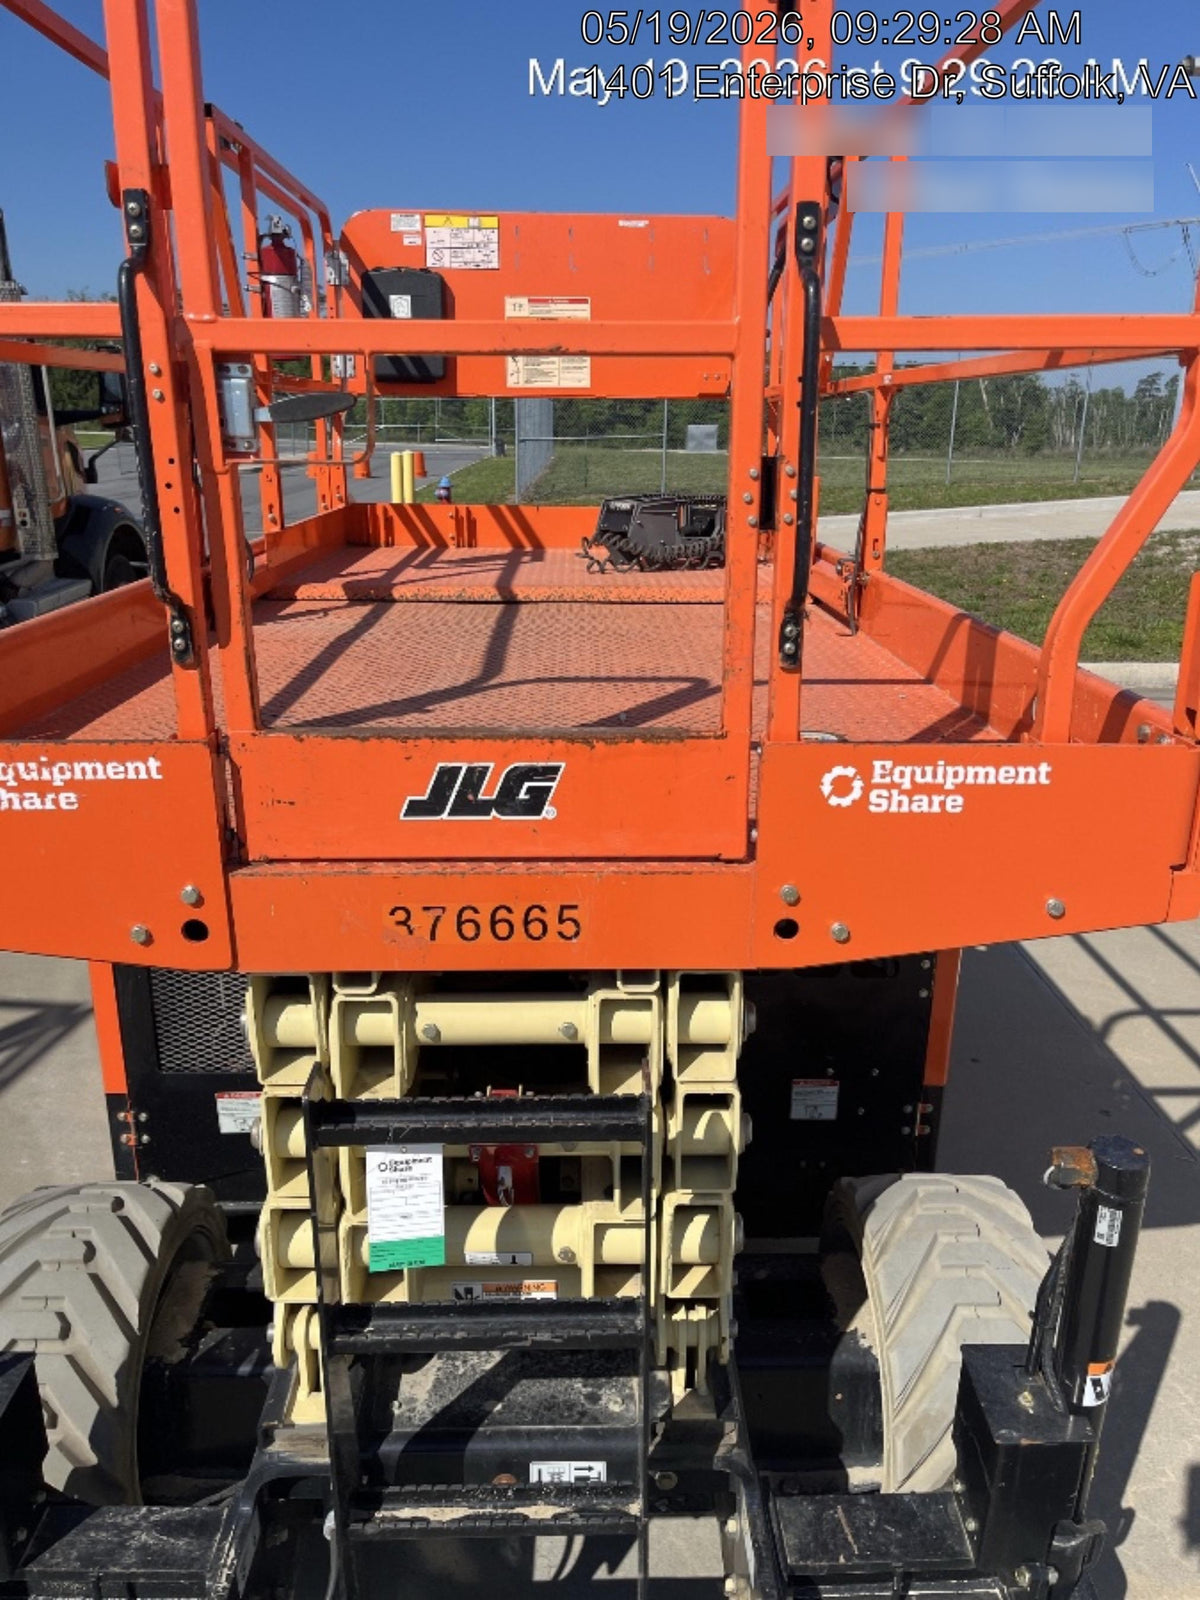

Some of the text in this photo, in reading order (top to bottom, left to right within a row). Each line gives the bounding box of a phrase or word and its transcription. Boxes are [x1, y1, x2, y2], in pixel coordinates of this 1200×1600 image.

[0, 756, 163, 786] quipment
[871, 760, 1052, 789] Equipment
[0, 787, 79, 811] hare
[400, 763, 566, 820] JLG
[868, 788, 964, 813] Share
[388, 904, 581, 942] 376665
